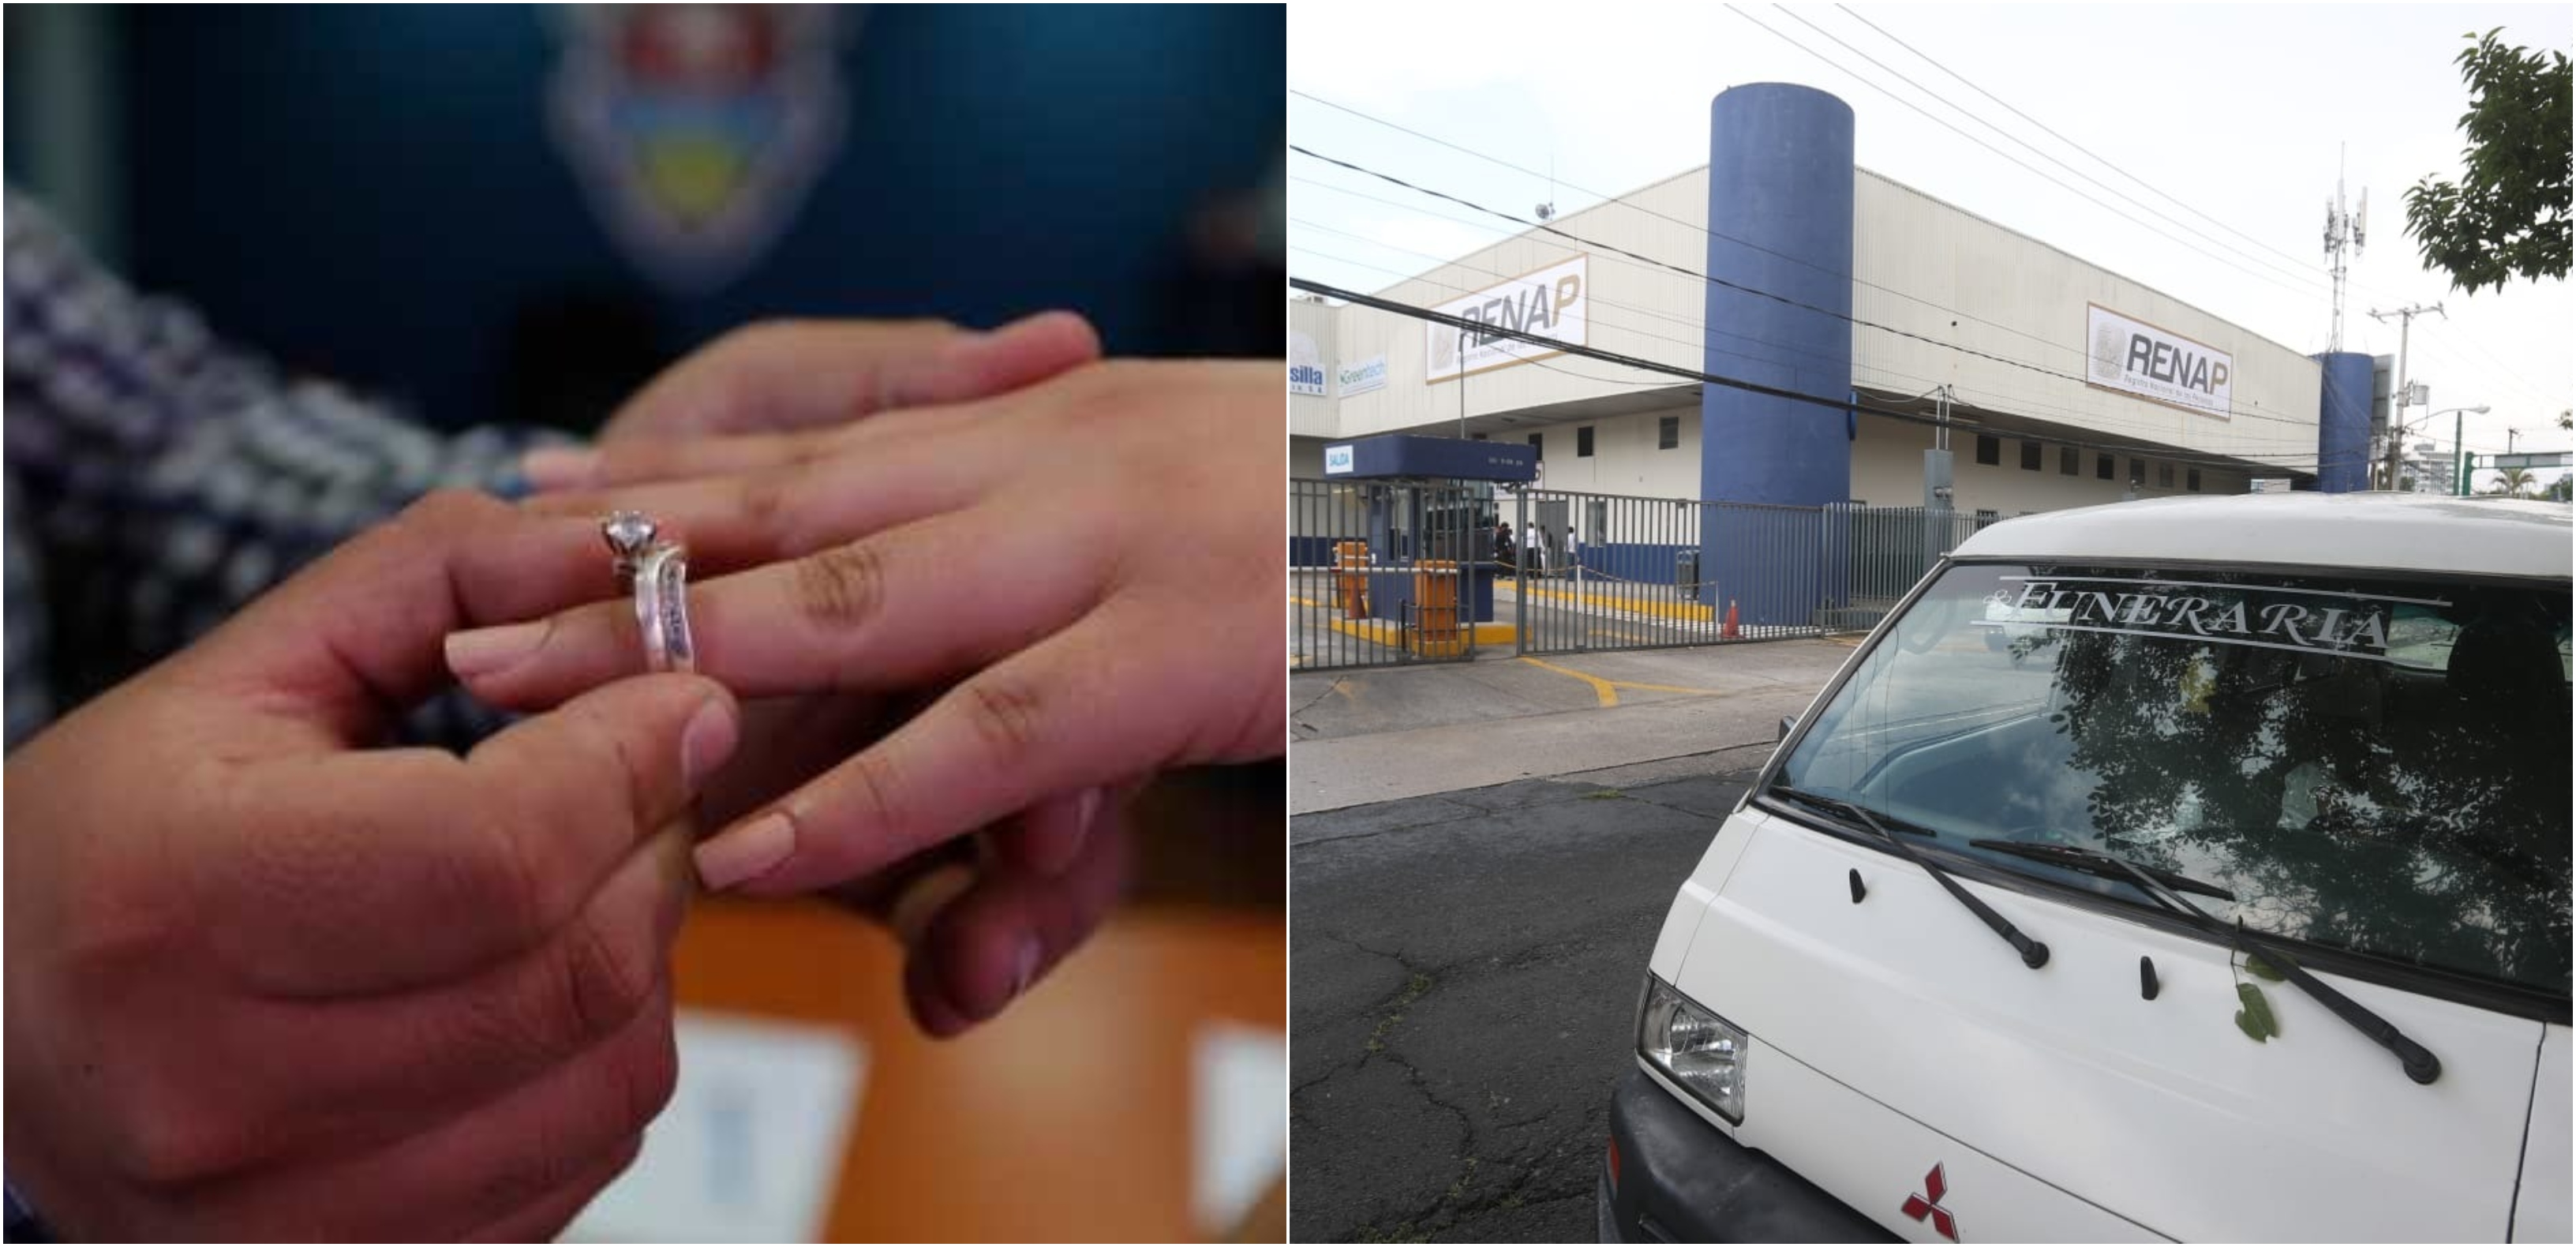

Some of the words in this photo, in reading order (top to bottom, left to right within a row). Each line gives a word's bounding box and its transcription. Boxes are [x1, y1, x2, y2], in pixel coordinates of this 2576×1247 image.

[1458, 274, 1581, 352] RENAP
[1290, 365, 1323, 385] silla
[2126, 333, 2228, 395] RENAP
[2005, 582, 2389, 649] FUNERARIA
